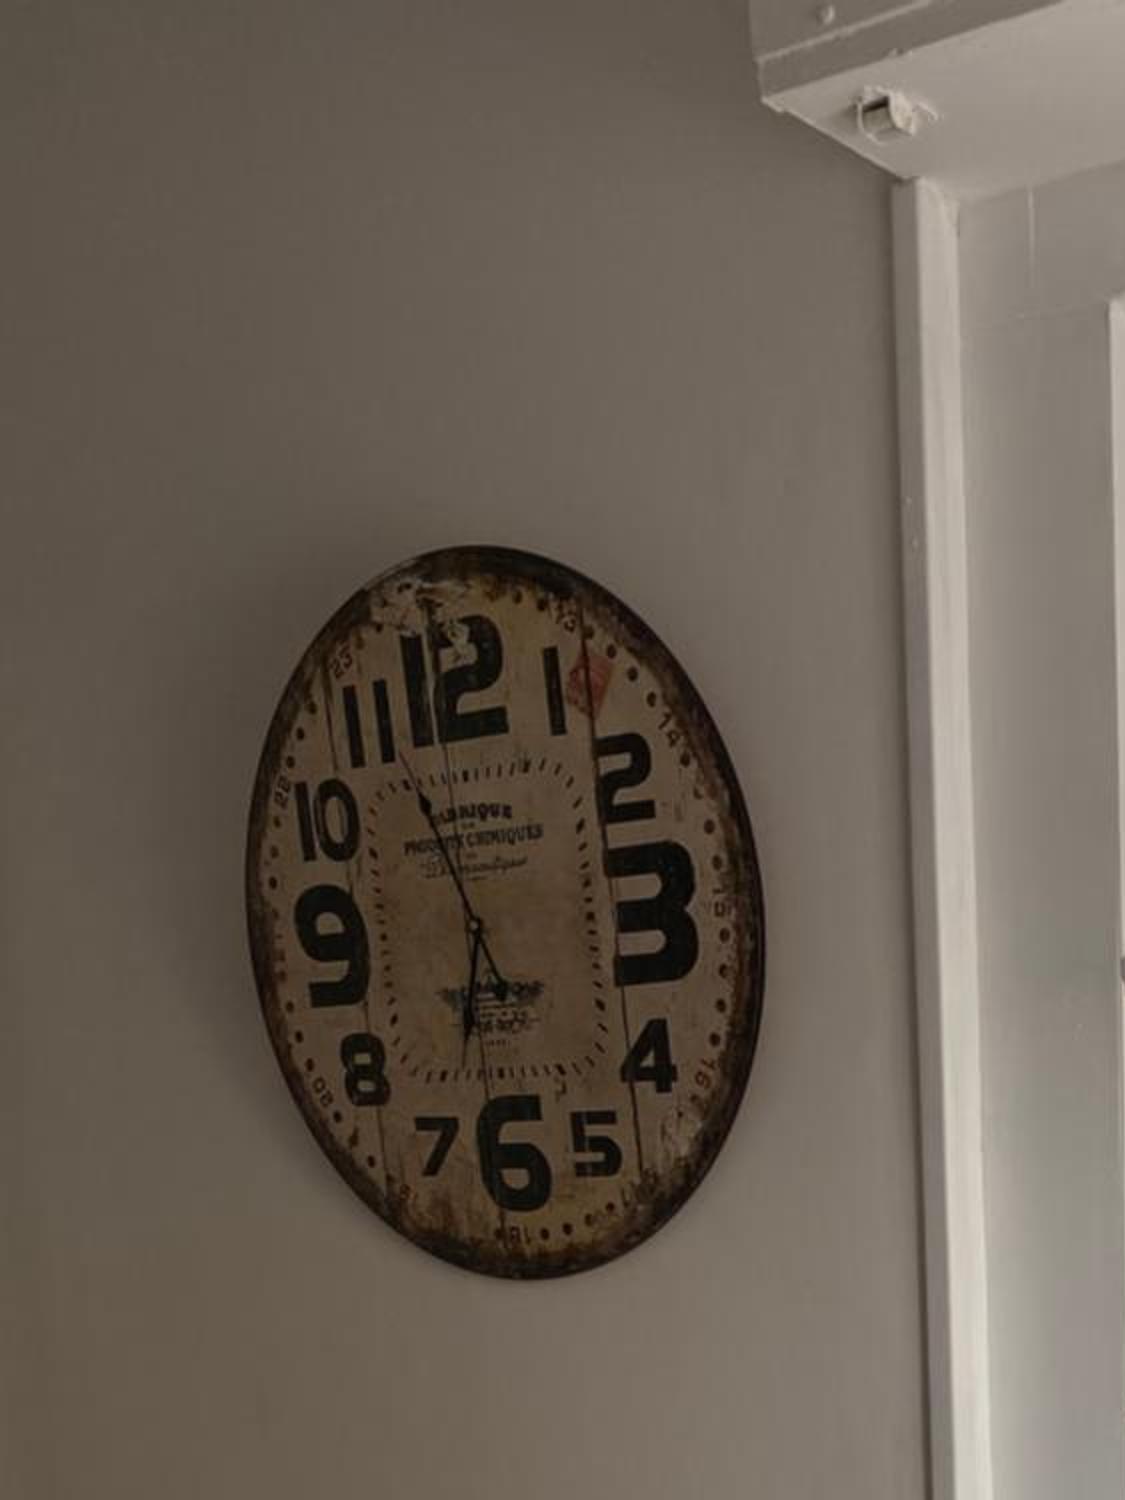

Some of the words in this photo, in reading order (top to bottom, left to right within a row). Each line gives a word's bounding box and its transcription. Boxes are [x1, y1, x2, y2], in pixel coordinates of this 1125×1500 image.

[343, 680, 396, 768] 11
[403, 614, 509, 746] 12
[542, 646, 567, 737] 1
[294, 777, 361, 863] 10
[594, 731, 657, 824] 2
[295, 883, 370, 1009] 9
[605, 840, 698, 988] 3
[339, 1033, 390, 1107] 8
[621, 1018, 678, 1094] 4
[415, 1118, 459, 1177] 7
[476, 1094, 552, 1213] 6
[572, 1109, 623, 1178] 5
